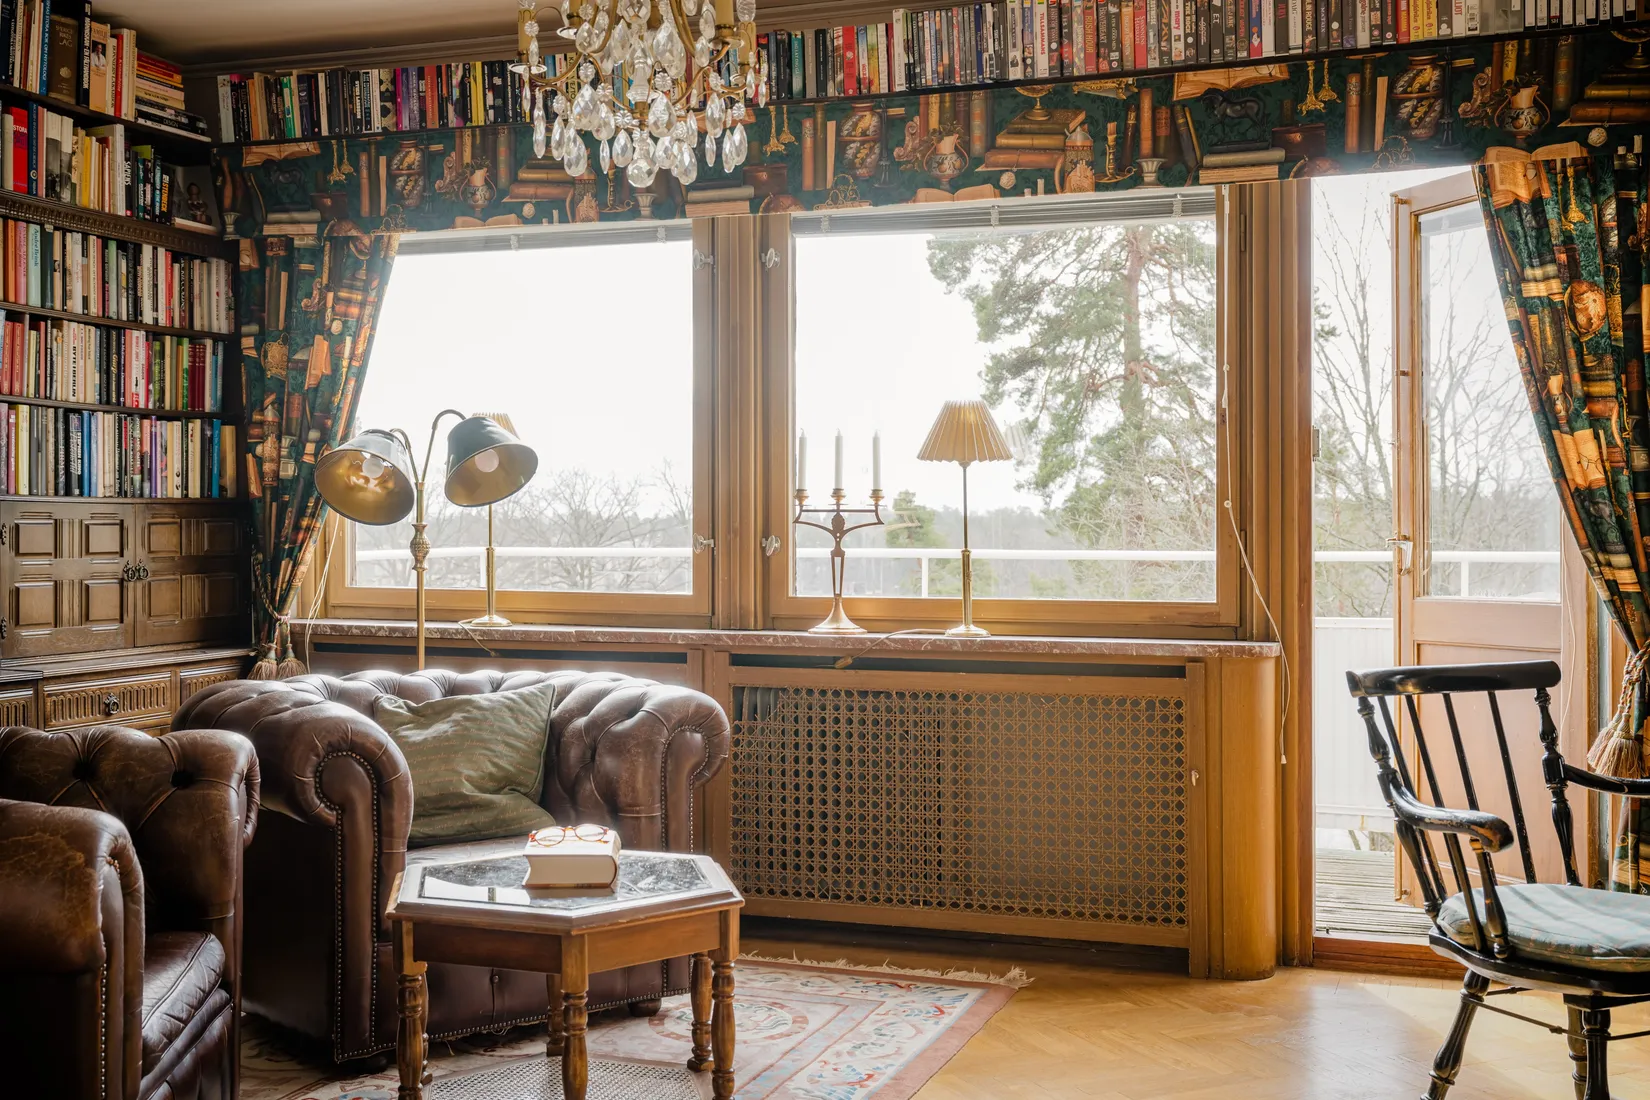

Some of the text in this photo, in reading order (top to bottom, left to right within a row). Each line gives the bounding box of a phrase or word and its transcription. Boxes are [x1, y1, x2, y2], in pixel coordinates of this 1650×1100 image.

[1084, 15, 1093, 53] RUSH HOUR
[1098, 6, 1108, 43] BRAVEHEART
